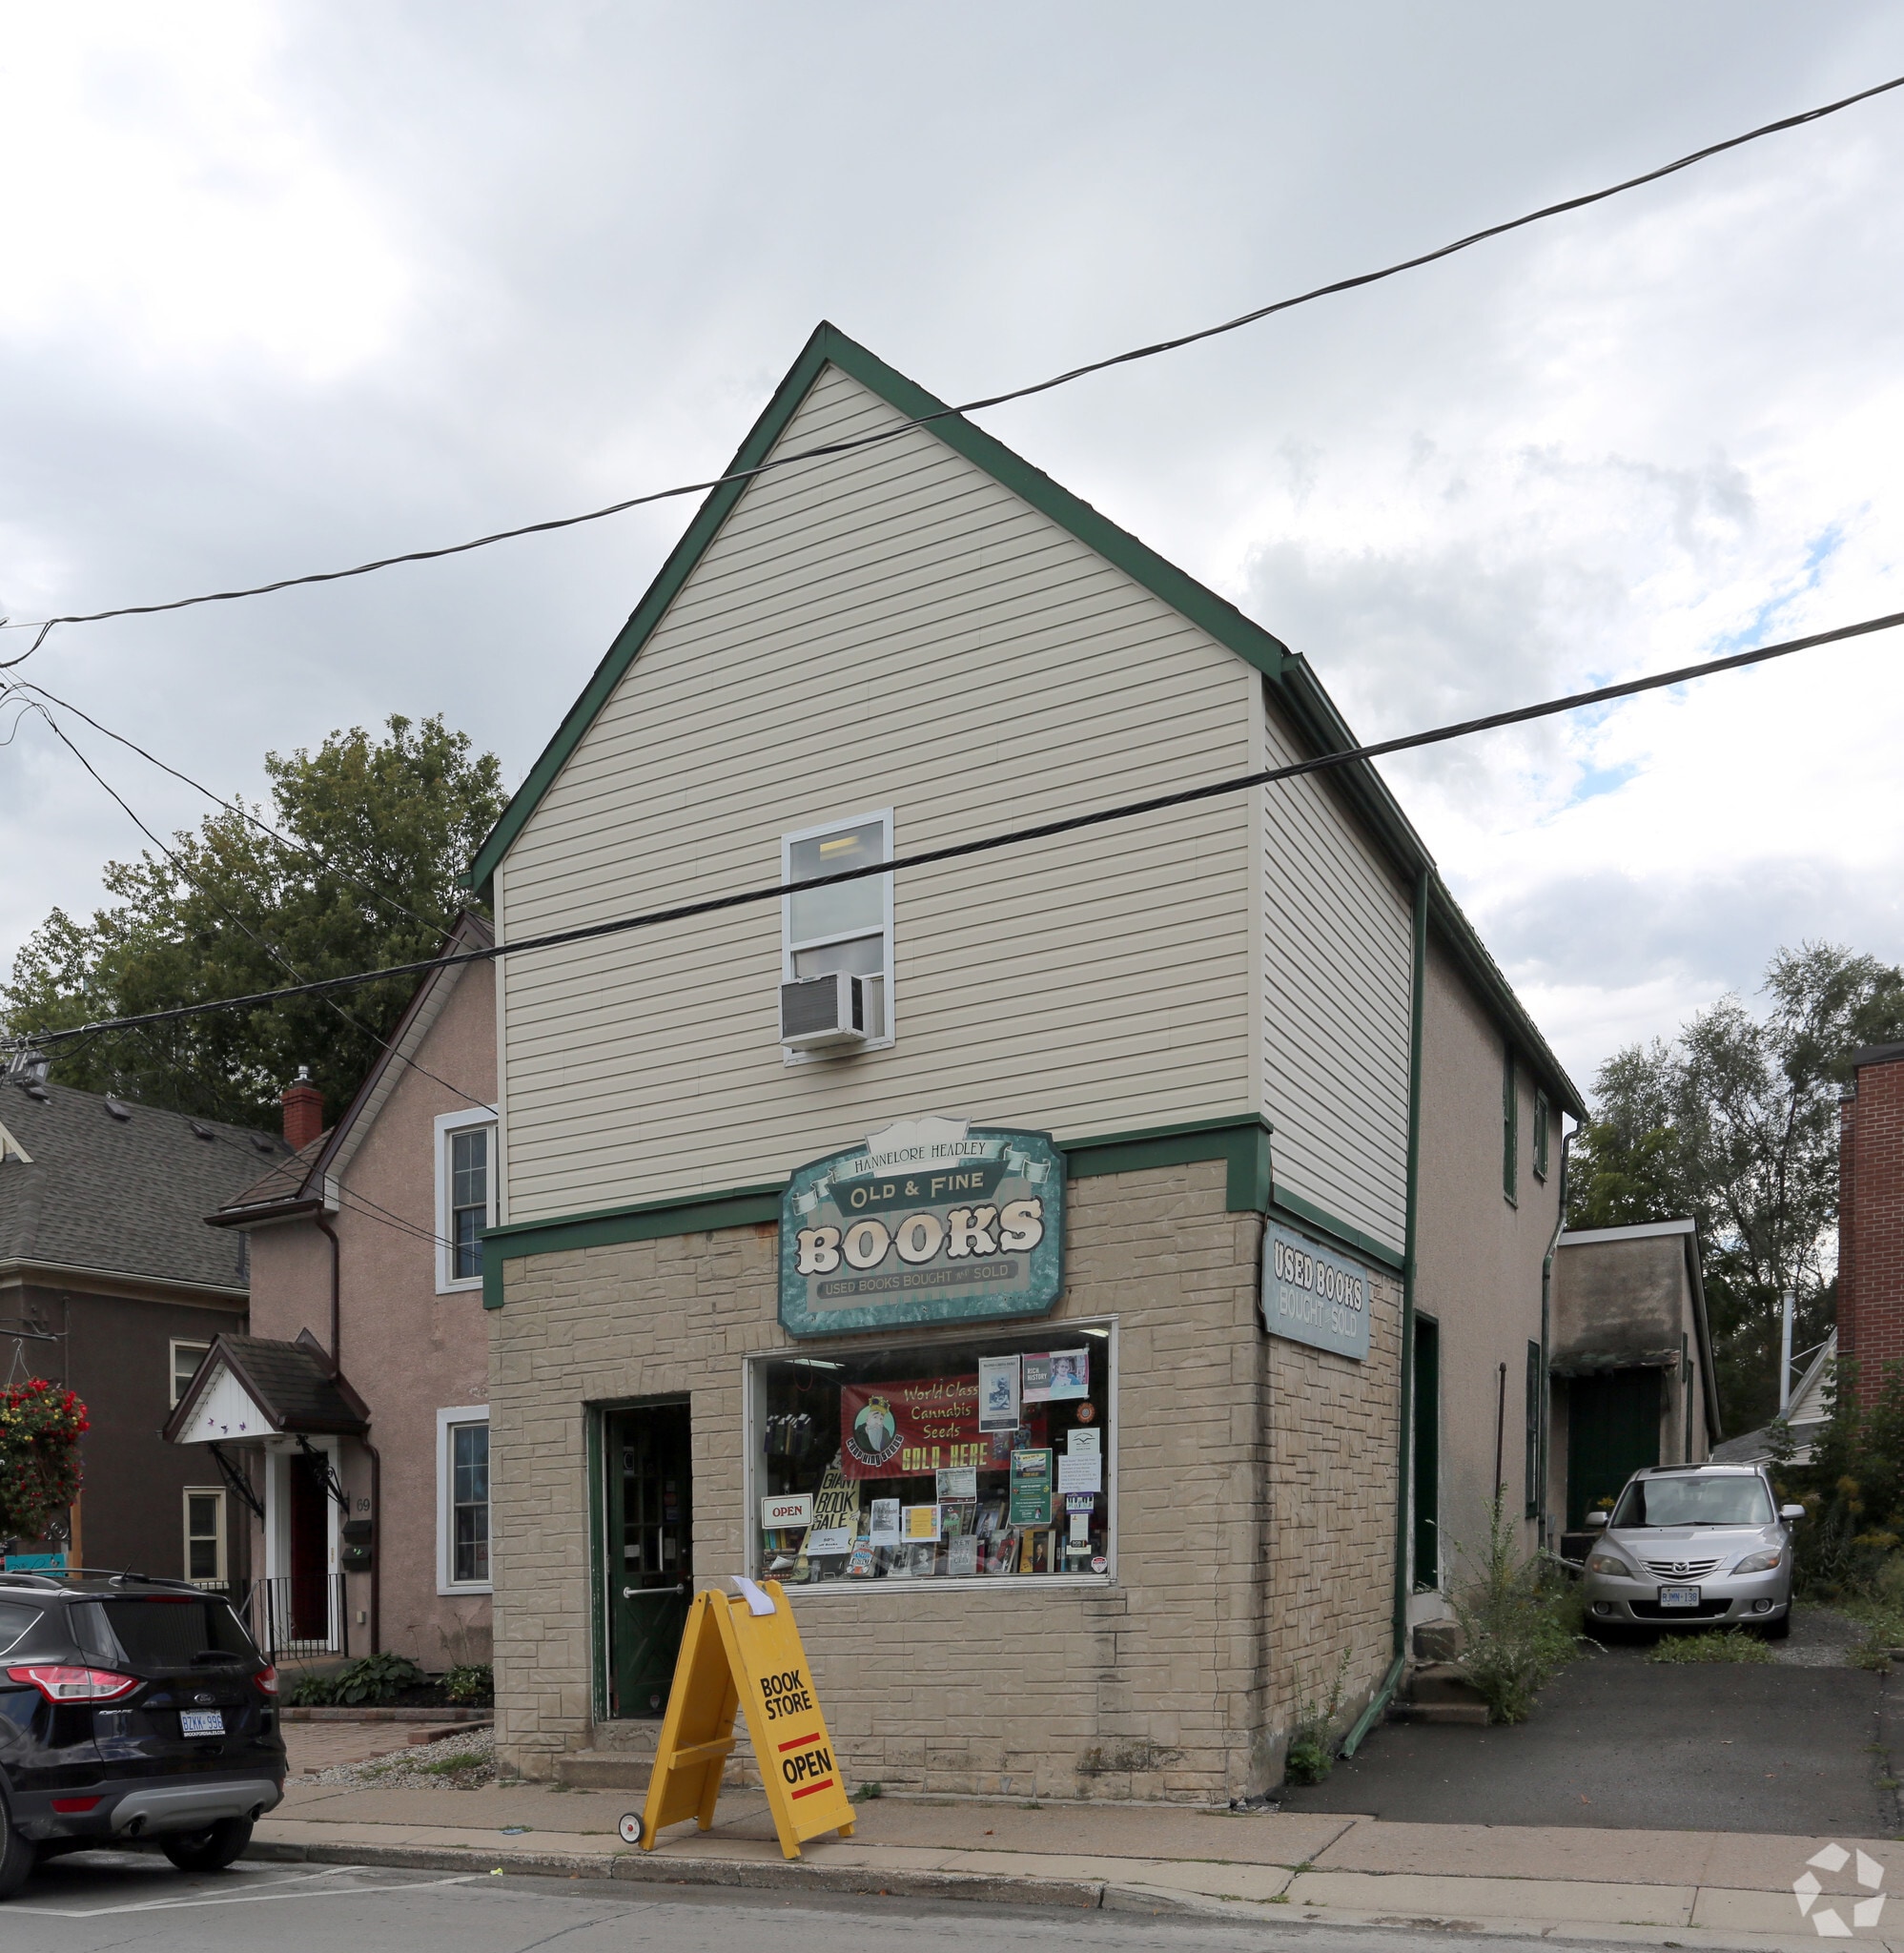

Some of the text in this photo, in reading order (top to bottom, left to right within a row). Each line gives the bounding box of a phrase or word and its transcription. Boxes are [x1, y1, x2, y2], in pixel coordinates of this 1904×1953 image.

[854, 1141, 986, 1173] HANNELORE HEADLEY
[850, 1172, 984, 1208] OLD & FINE
[795, 1195, 1045, 1276] BOOKS
[826, 1281, 854, 1295] USED
[859, 1276, 900, 1291] BOOKS
[904, 1271, 952, 1286] BOUGHT
[973, 1264, 1009, 1279] SOLD
[1274, 1239, 1362, 1312] USED BOOKS
[1280, 1285, 1323, 1328] BOUGHT
[1331, 1306, 1357, 1338] SOLD
[904, 1382, 979, 1402] World Class
[911, 1402, 972, 1420] Cannabis
[923, 1423, 961, 1439] Seeds
[902, 1443, 988, 1470] SOLD HERE
[357, 1498, 370, 1511] 69
[772, 1506, 803, 1517] OPEN
[816, 1490, 855, 1513] BOOK
[811, 1512, 848, 1531] SALE
[1685, 1593, 1697, 1602] 138
[760, 1670, 804, 1698] BOOK
[765, 1690, 812, 1720] STORE
[182, 1715, 223, 1731] BZKK 996
[783, 1748, 832, 1784] OPEN
